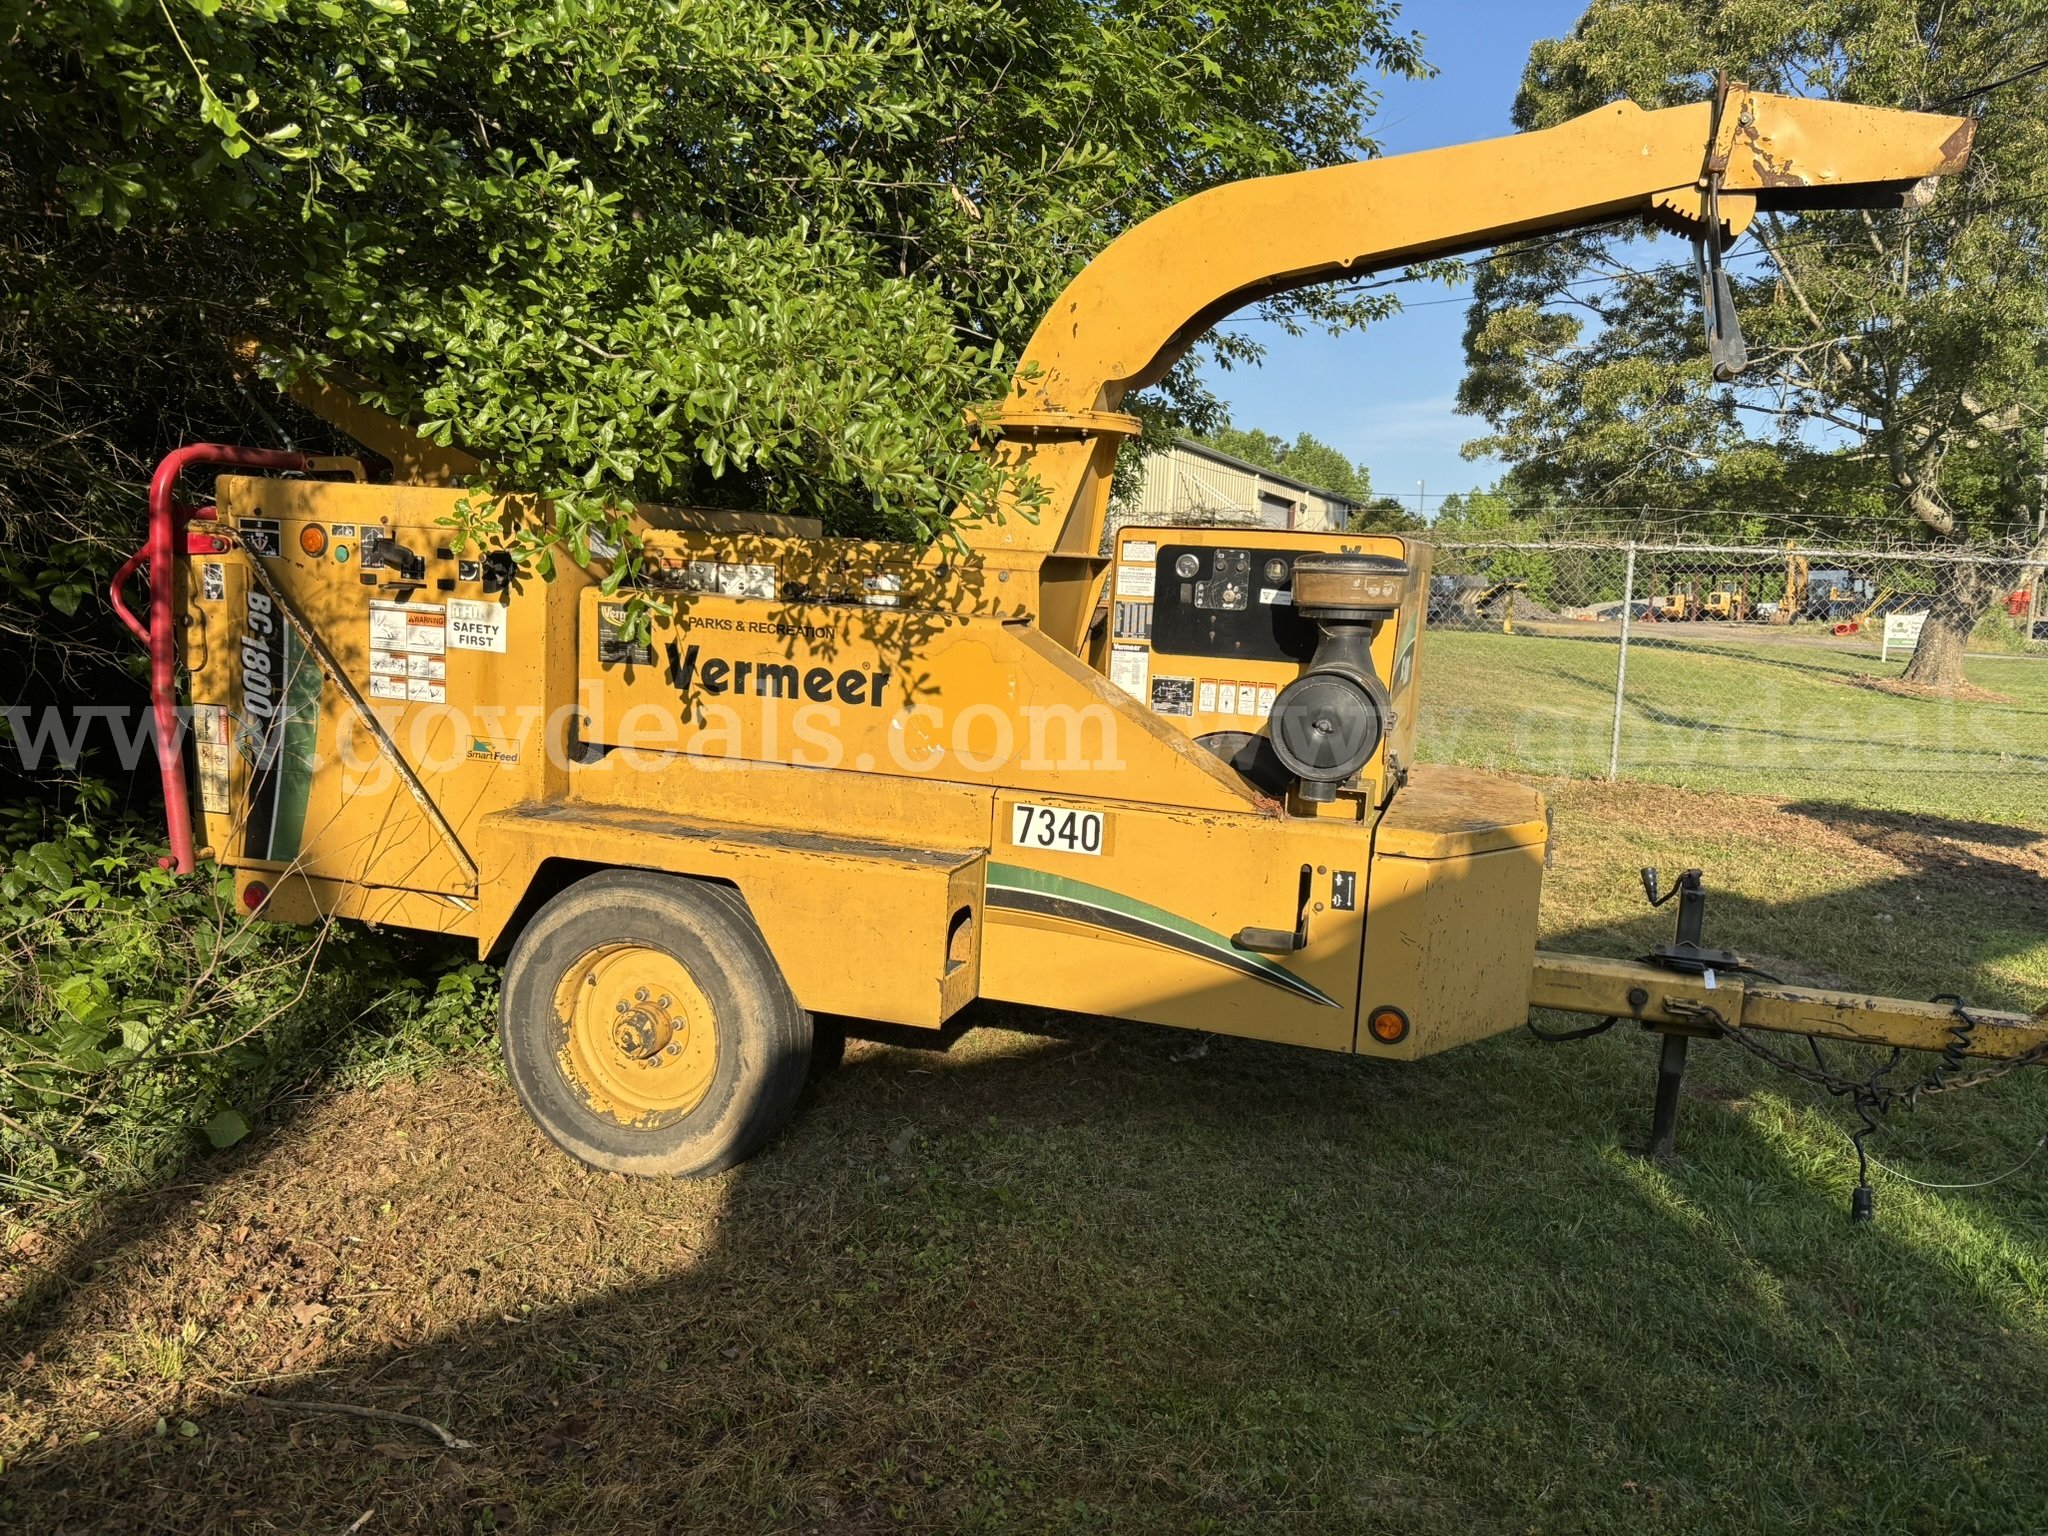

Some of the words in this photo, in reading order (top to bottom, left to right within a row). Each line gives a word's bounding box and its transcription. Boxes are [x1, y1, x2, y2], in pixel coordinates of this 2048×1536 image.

[414, 616, 444, 625] WARNING
[453, 621, 499, 635] SAFETY
[689, 616, 732, 631] PARKS
[735, 620, 746, 632] &
[748, 621, 835, 640] RECREATION
[459, 634, 494, 647] FIRST
[665, 643, 890, 707] Vermeer
[1017, 805, 1100, 851] 7340
